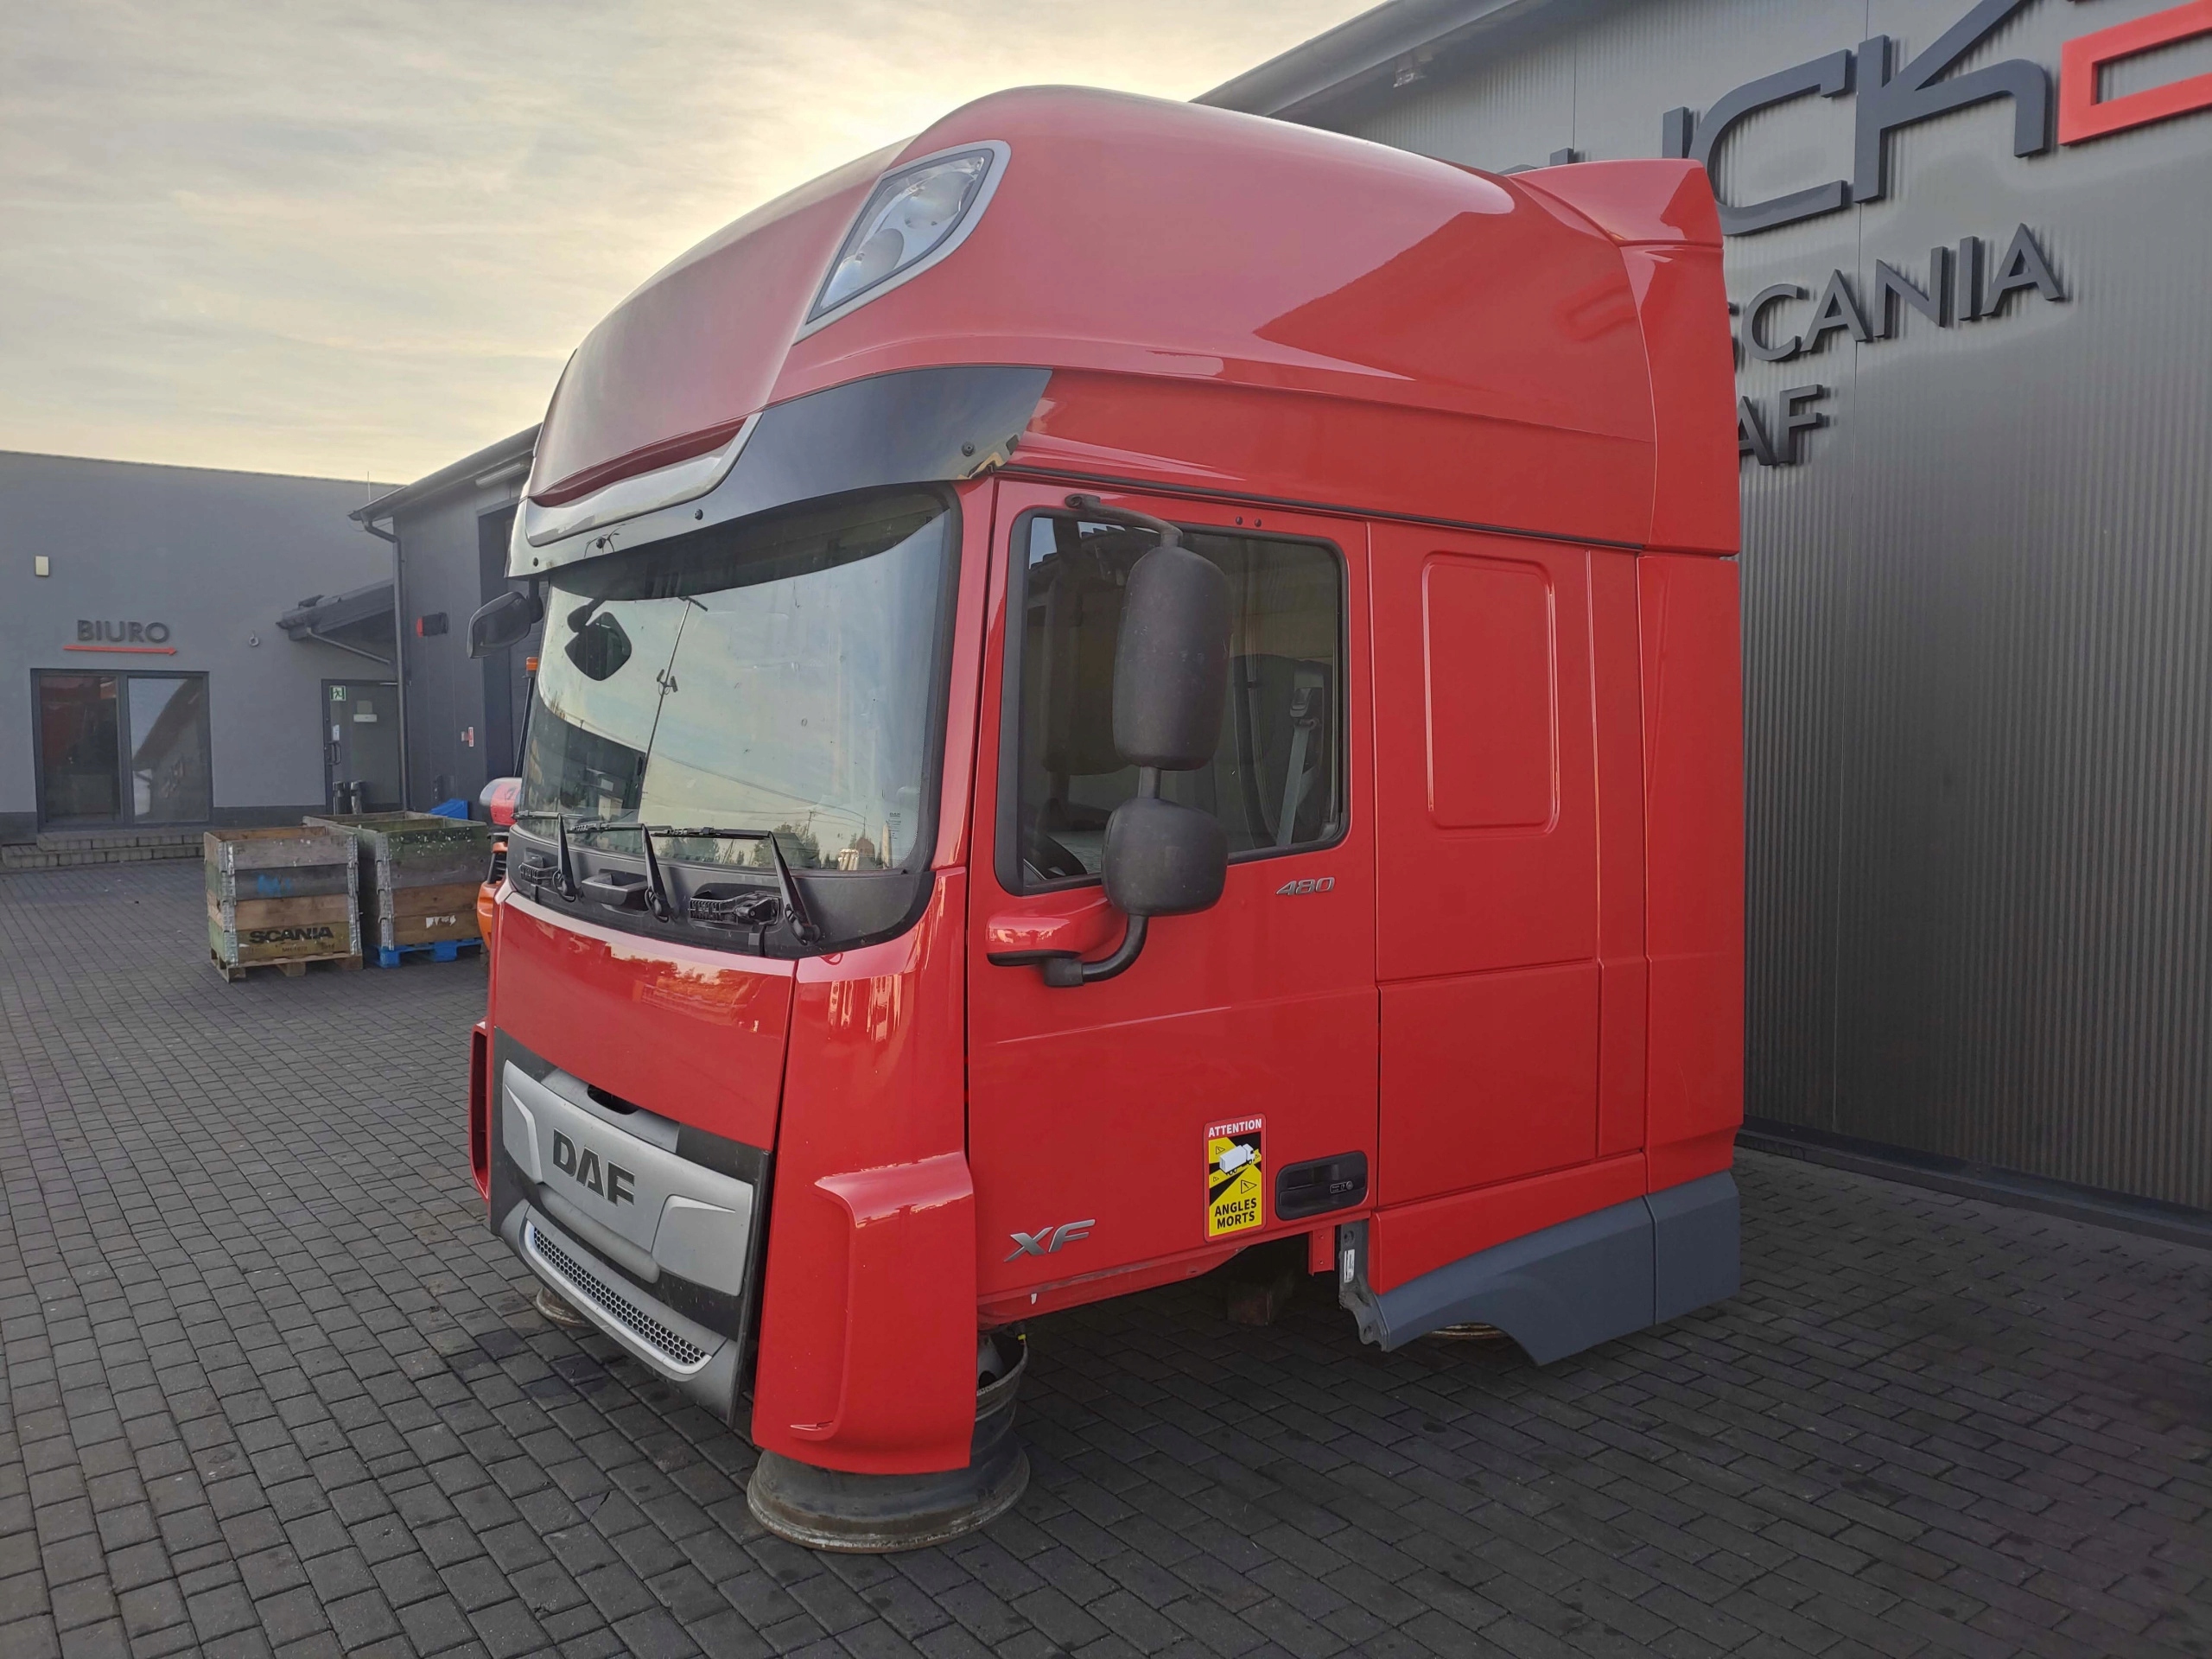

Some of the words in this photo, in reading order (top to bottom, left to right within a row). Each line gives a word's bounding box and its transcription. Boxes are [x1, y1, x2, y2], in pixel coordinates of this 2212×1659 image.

[1730, 222, 2065, 363] CANIA
[1737, 385, 1823, 467] AF
[77, 620, 170, 643] BIURO
[1276, 877, 1336, 896] 480
[249, 926, 334, 944] SCANIA
[1208, 1118, 1262, 1138] ATTENTION
[553, 1128, 635, 1207] DAF
[1214, 1198, 1257, 1217] ANGLES
[1217, 1211, 1255, 1230] MORTS
[1003, 1218, 1096, 1262] XF
